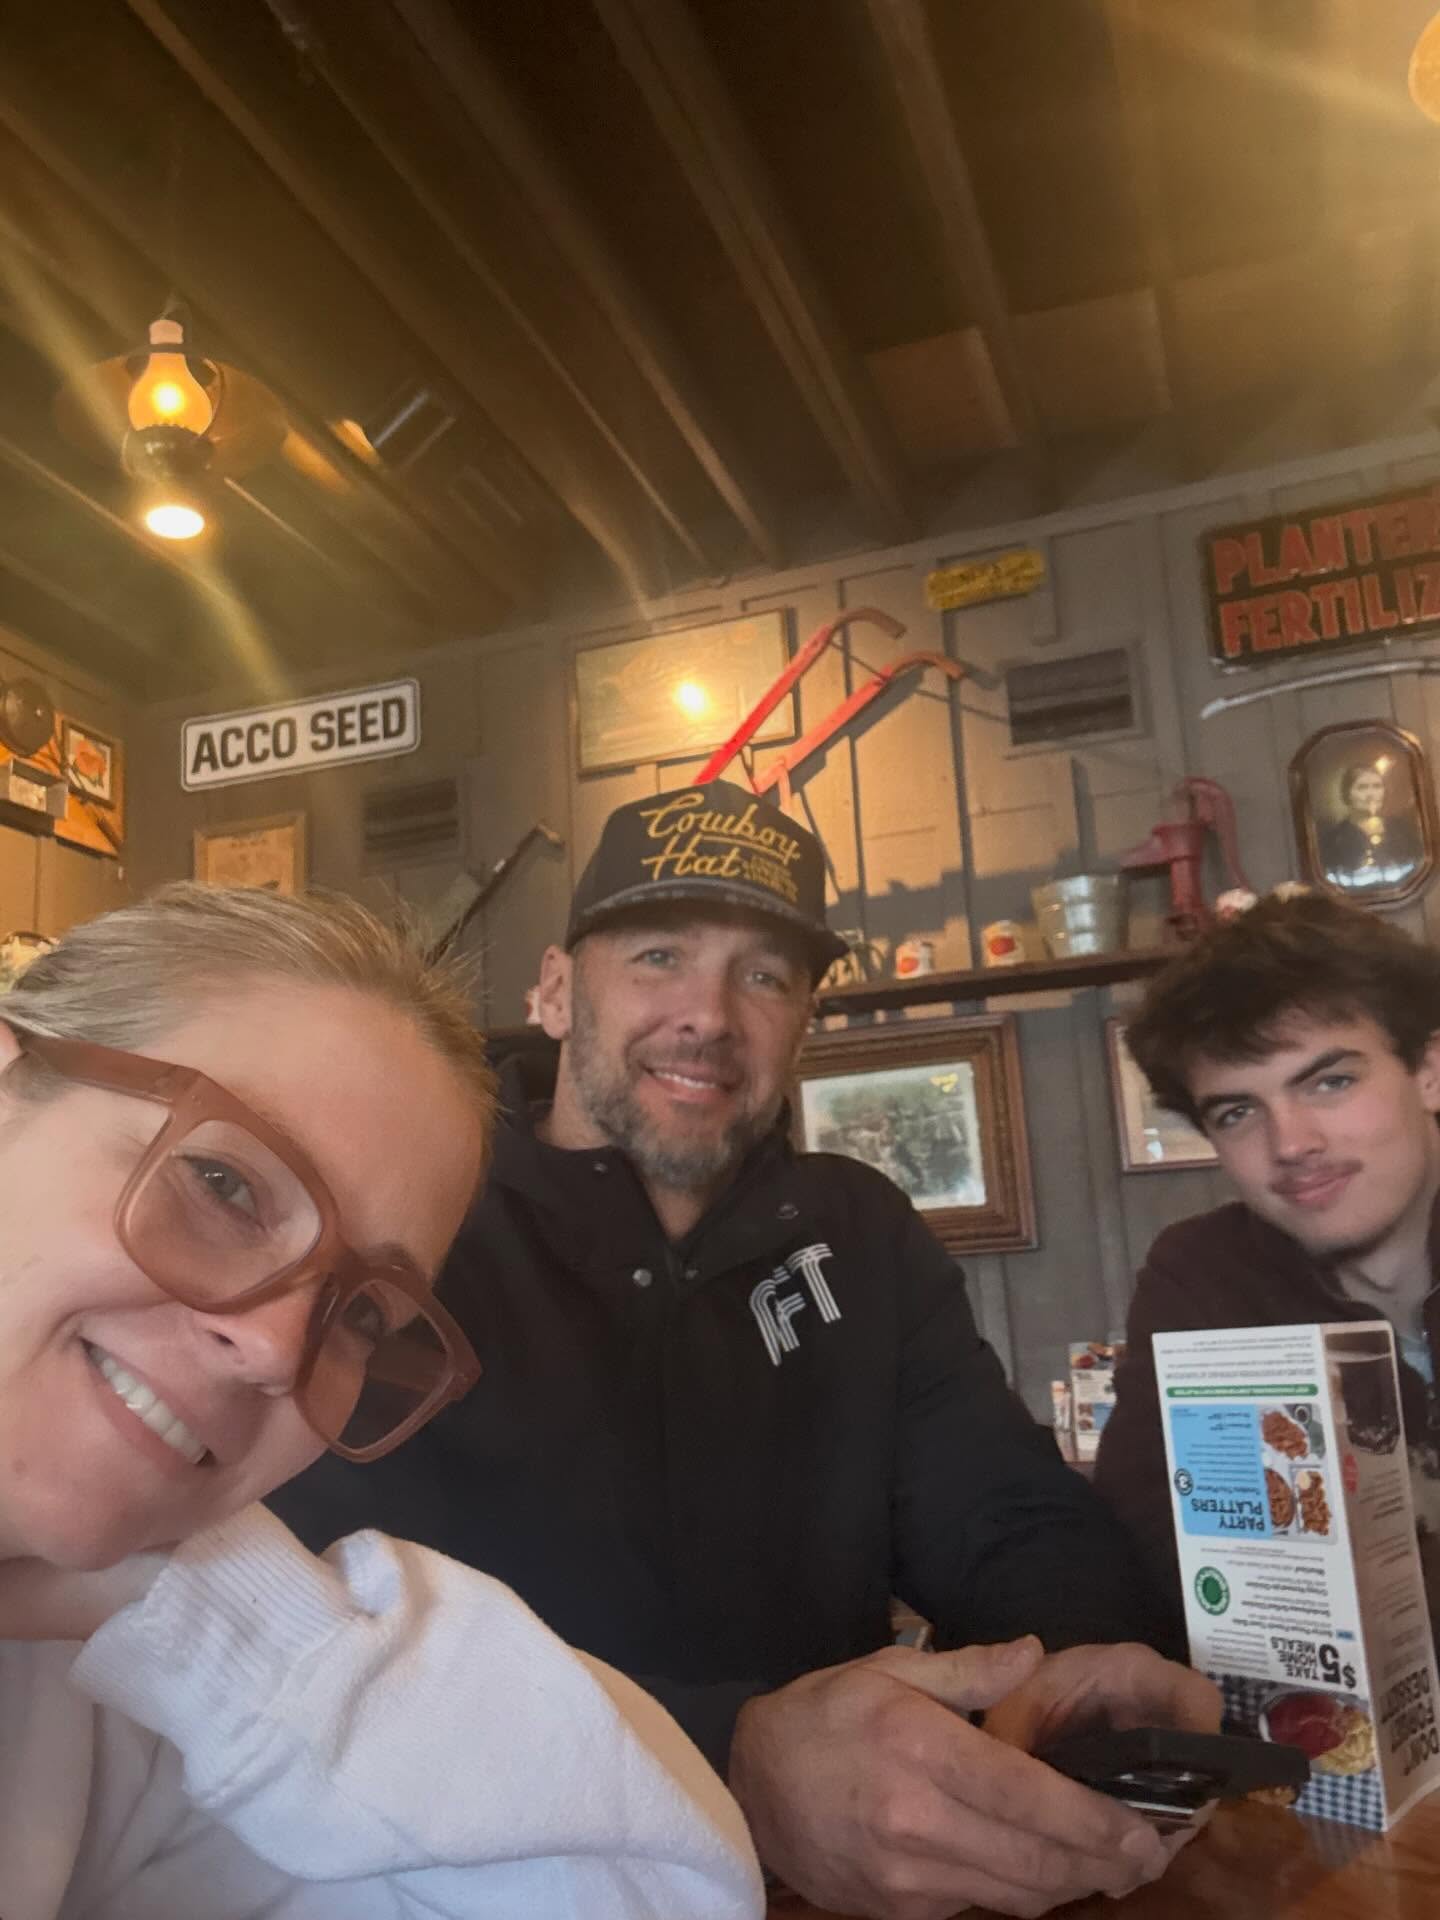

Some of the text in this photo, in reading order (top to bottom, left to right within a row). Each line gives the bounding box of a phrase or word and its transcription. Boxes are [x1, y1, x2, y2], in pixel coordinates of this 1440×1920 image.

[191, 697, 407, 774] ACCO SEED
[640, 793, 800, 865] Cowboy
[641, 831, 742, 881] Hat
[1190, 1498, 1264, 1518] PLATTERS
[1218, 1514, 1265, 1532] PARTY
[1271, 1636, 1316, 1654] MEALS
[1279, 1650, 1319, 1667] HOME
[1318, 1643, 1357, 1689] $5
[1285, 1664, 1321, 1681] TAKE
